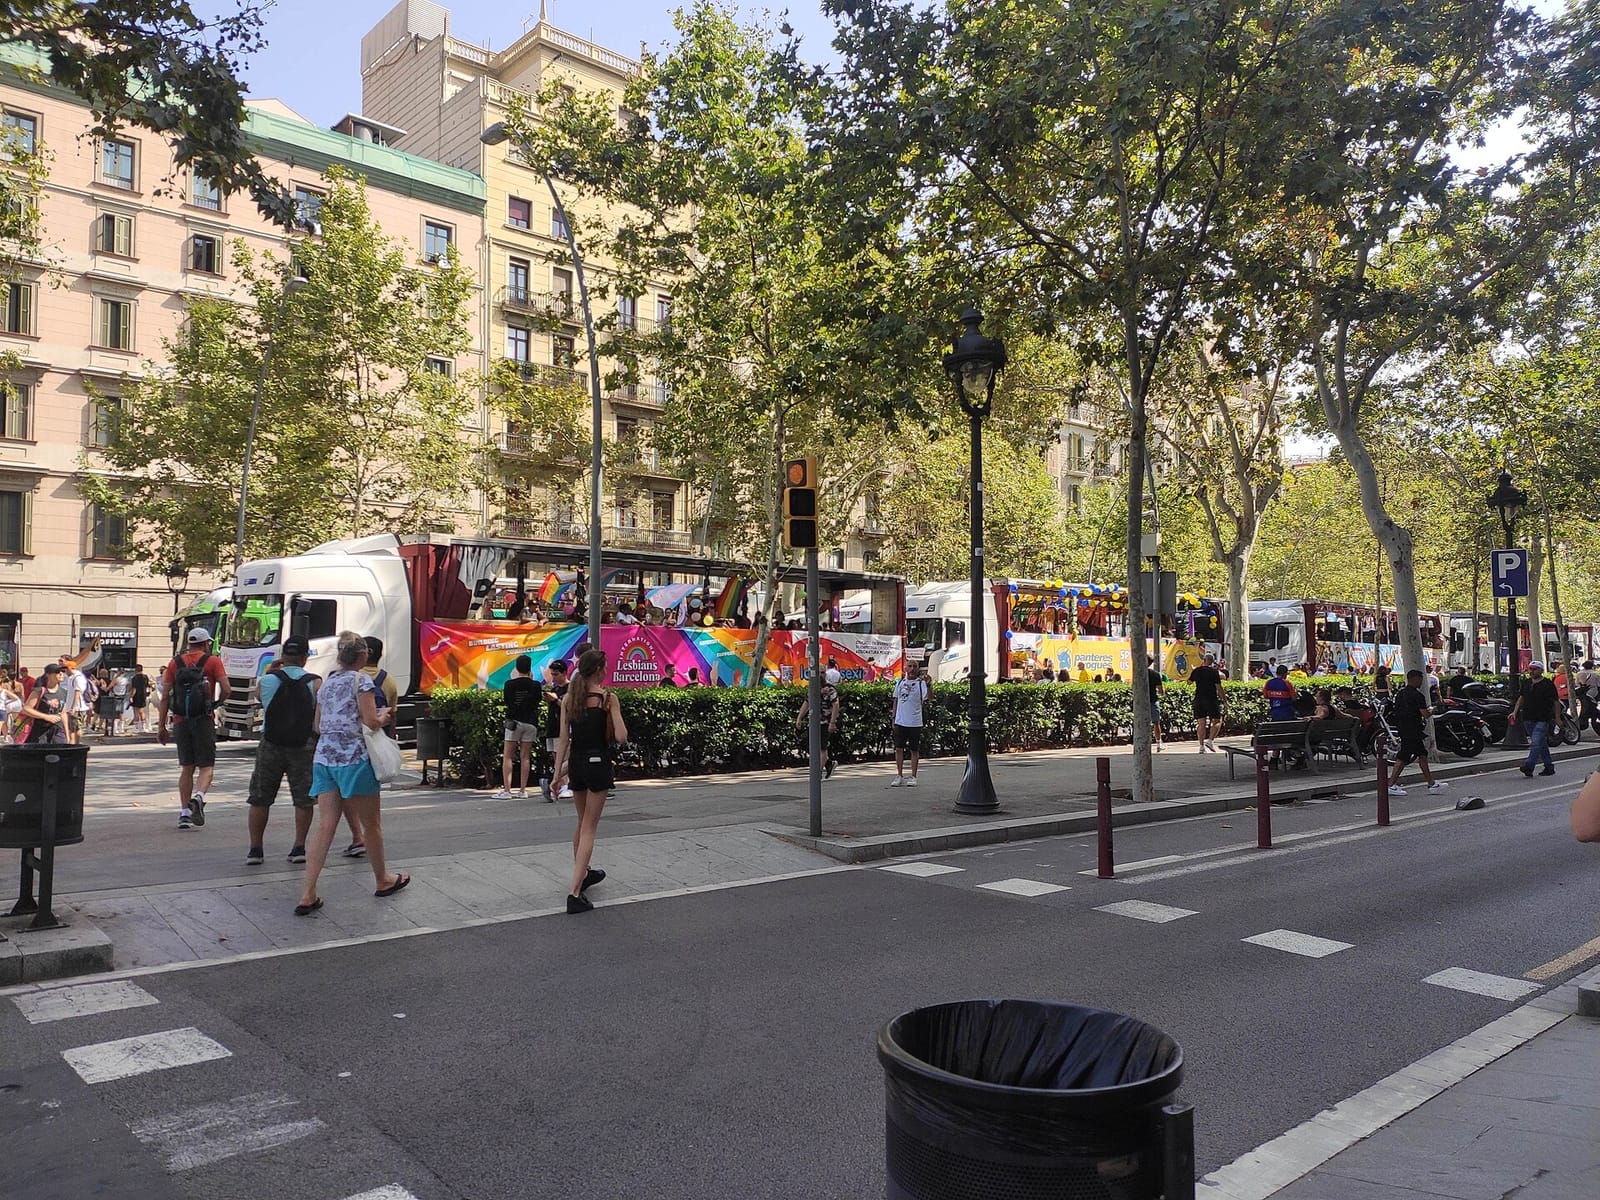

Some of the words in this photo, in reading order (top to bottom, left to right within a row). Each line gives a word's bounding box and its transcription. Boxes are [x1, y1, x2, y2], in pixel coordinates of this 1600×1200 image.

[1498, 553, 1521, 579] P
[619, 636, 656, 660] INTERNATIONAL
[616, 659, 658, 671] Lesbians
[1074, 653, 1113, 667] panteres
[612, 670, 661, 682] Barcelona
